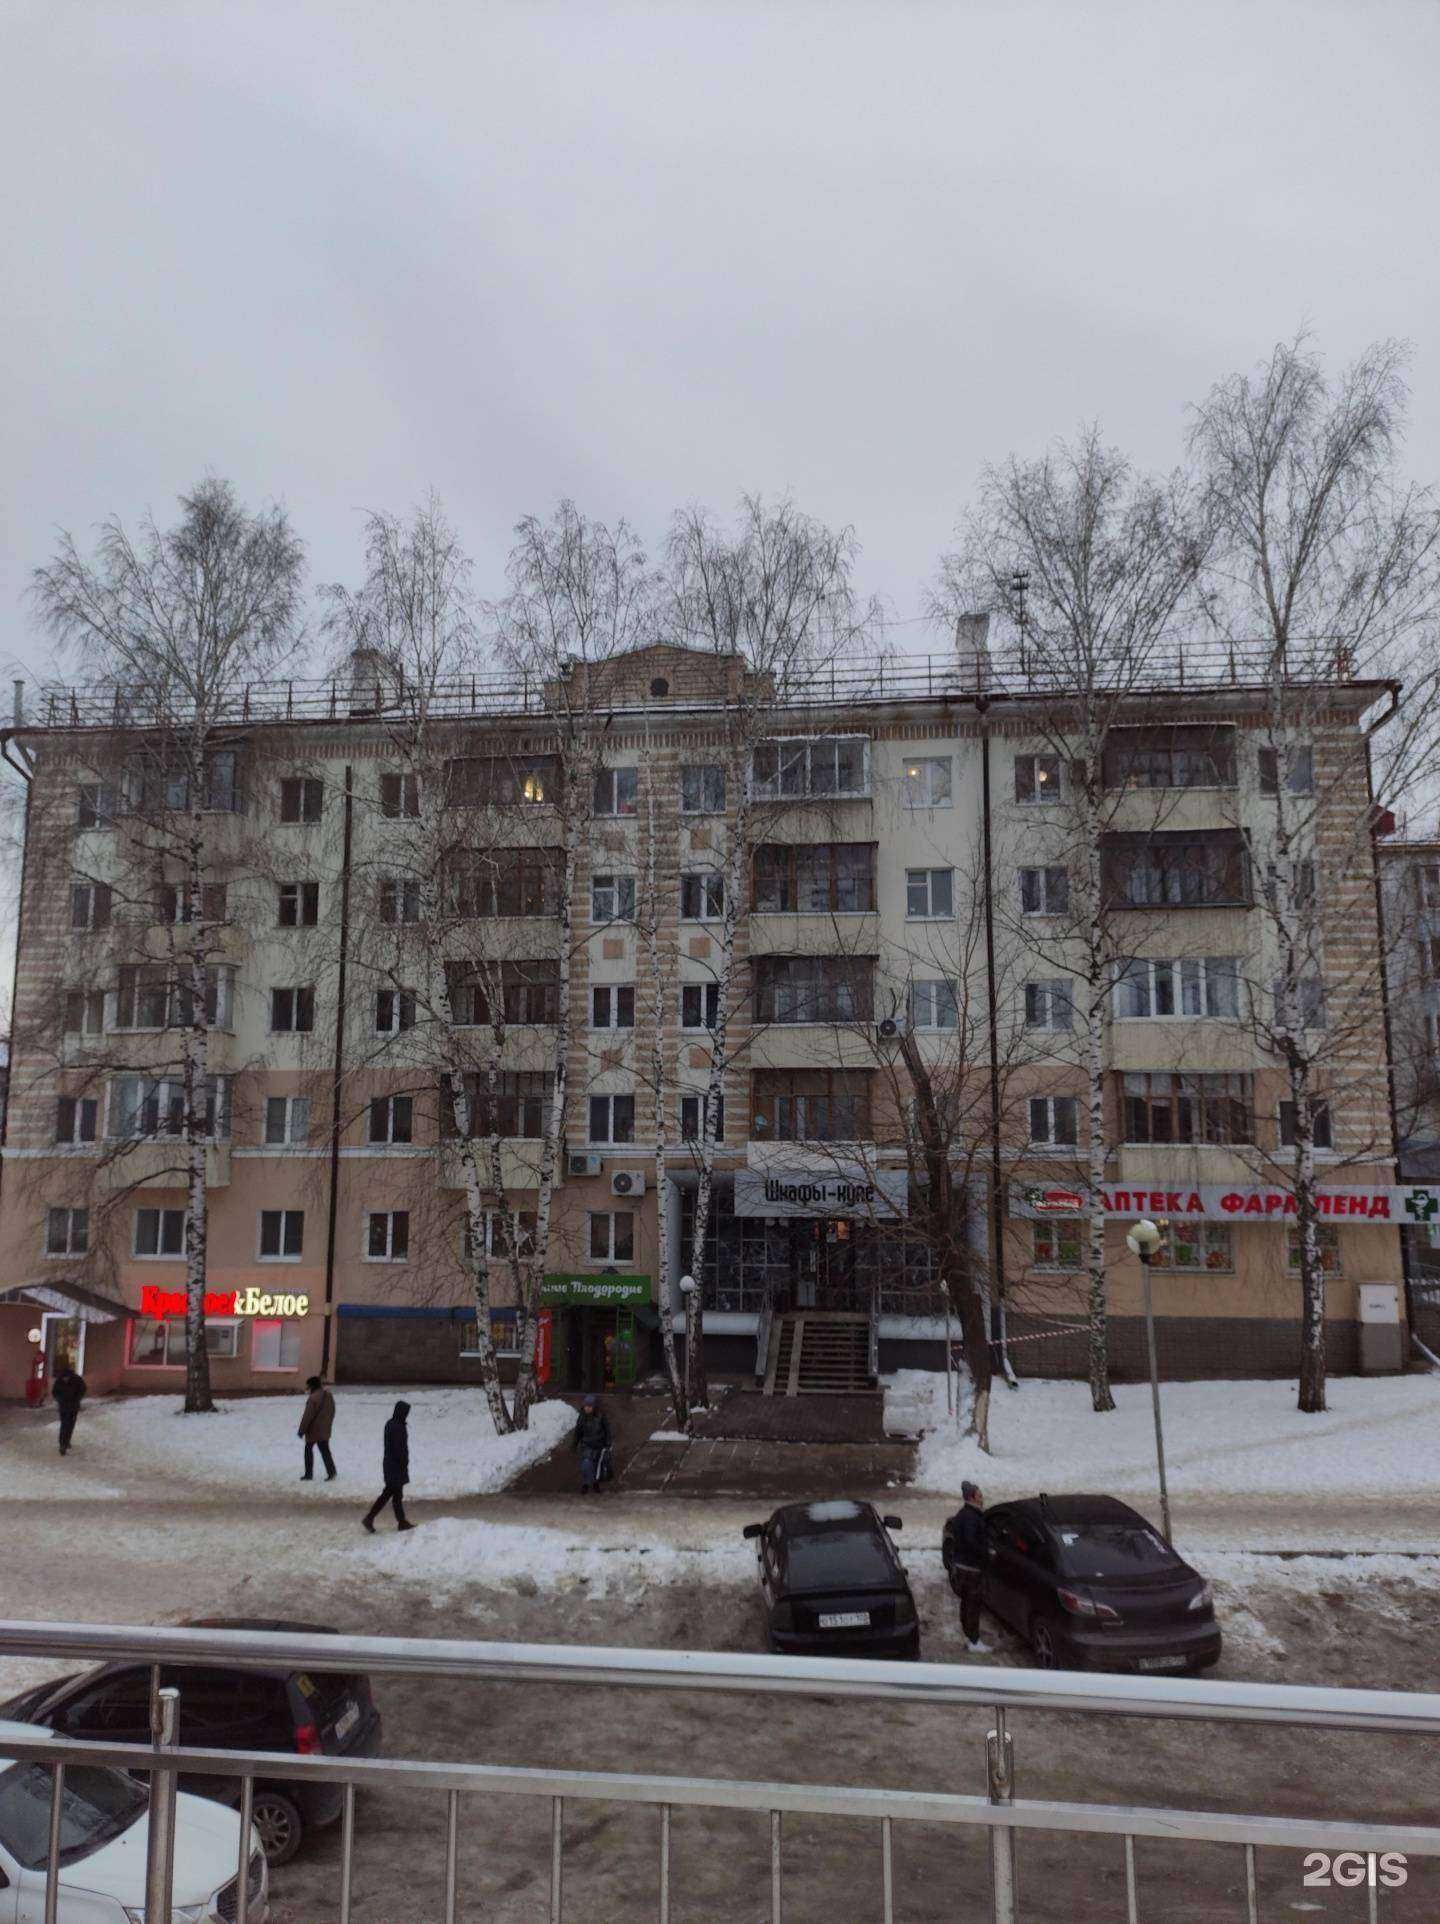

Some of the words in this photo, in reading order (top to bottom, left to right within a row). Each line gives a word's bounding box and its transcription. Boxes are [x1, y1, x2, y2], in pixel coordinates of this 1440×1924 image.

[765, 1179, 875, 1206] Шкафы-купе
[1100, 1191, 1205, 1213] АПТЕКА
[571, 1281, 643, 1298] Плодородие
